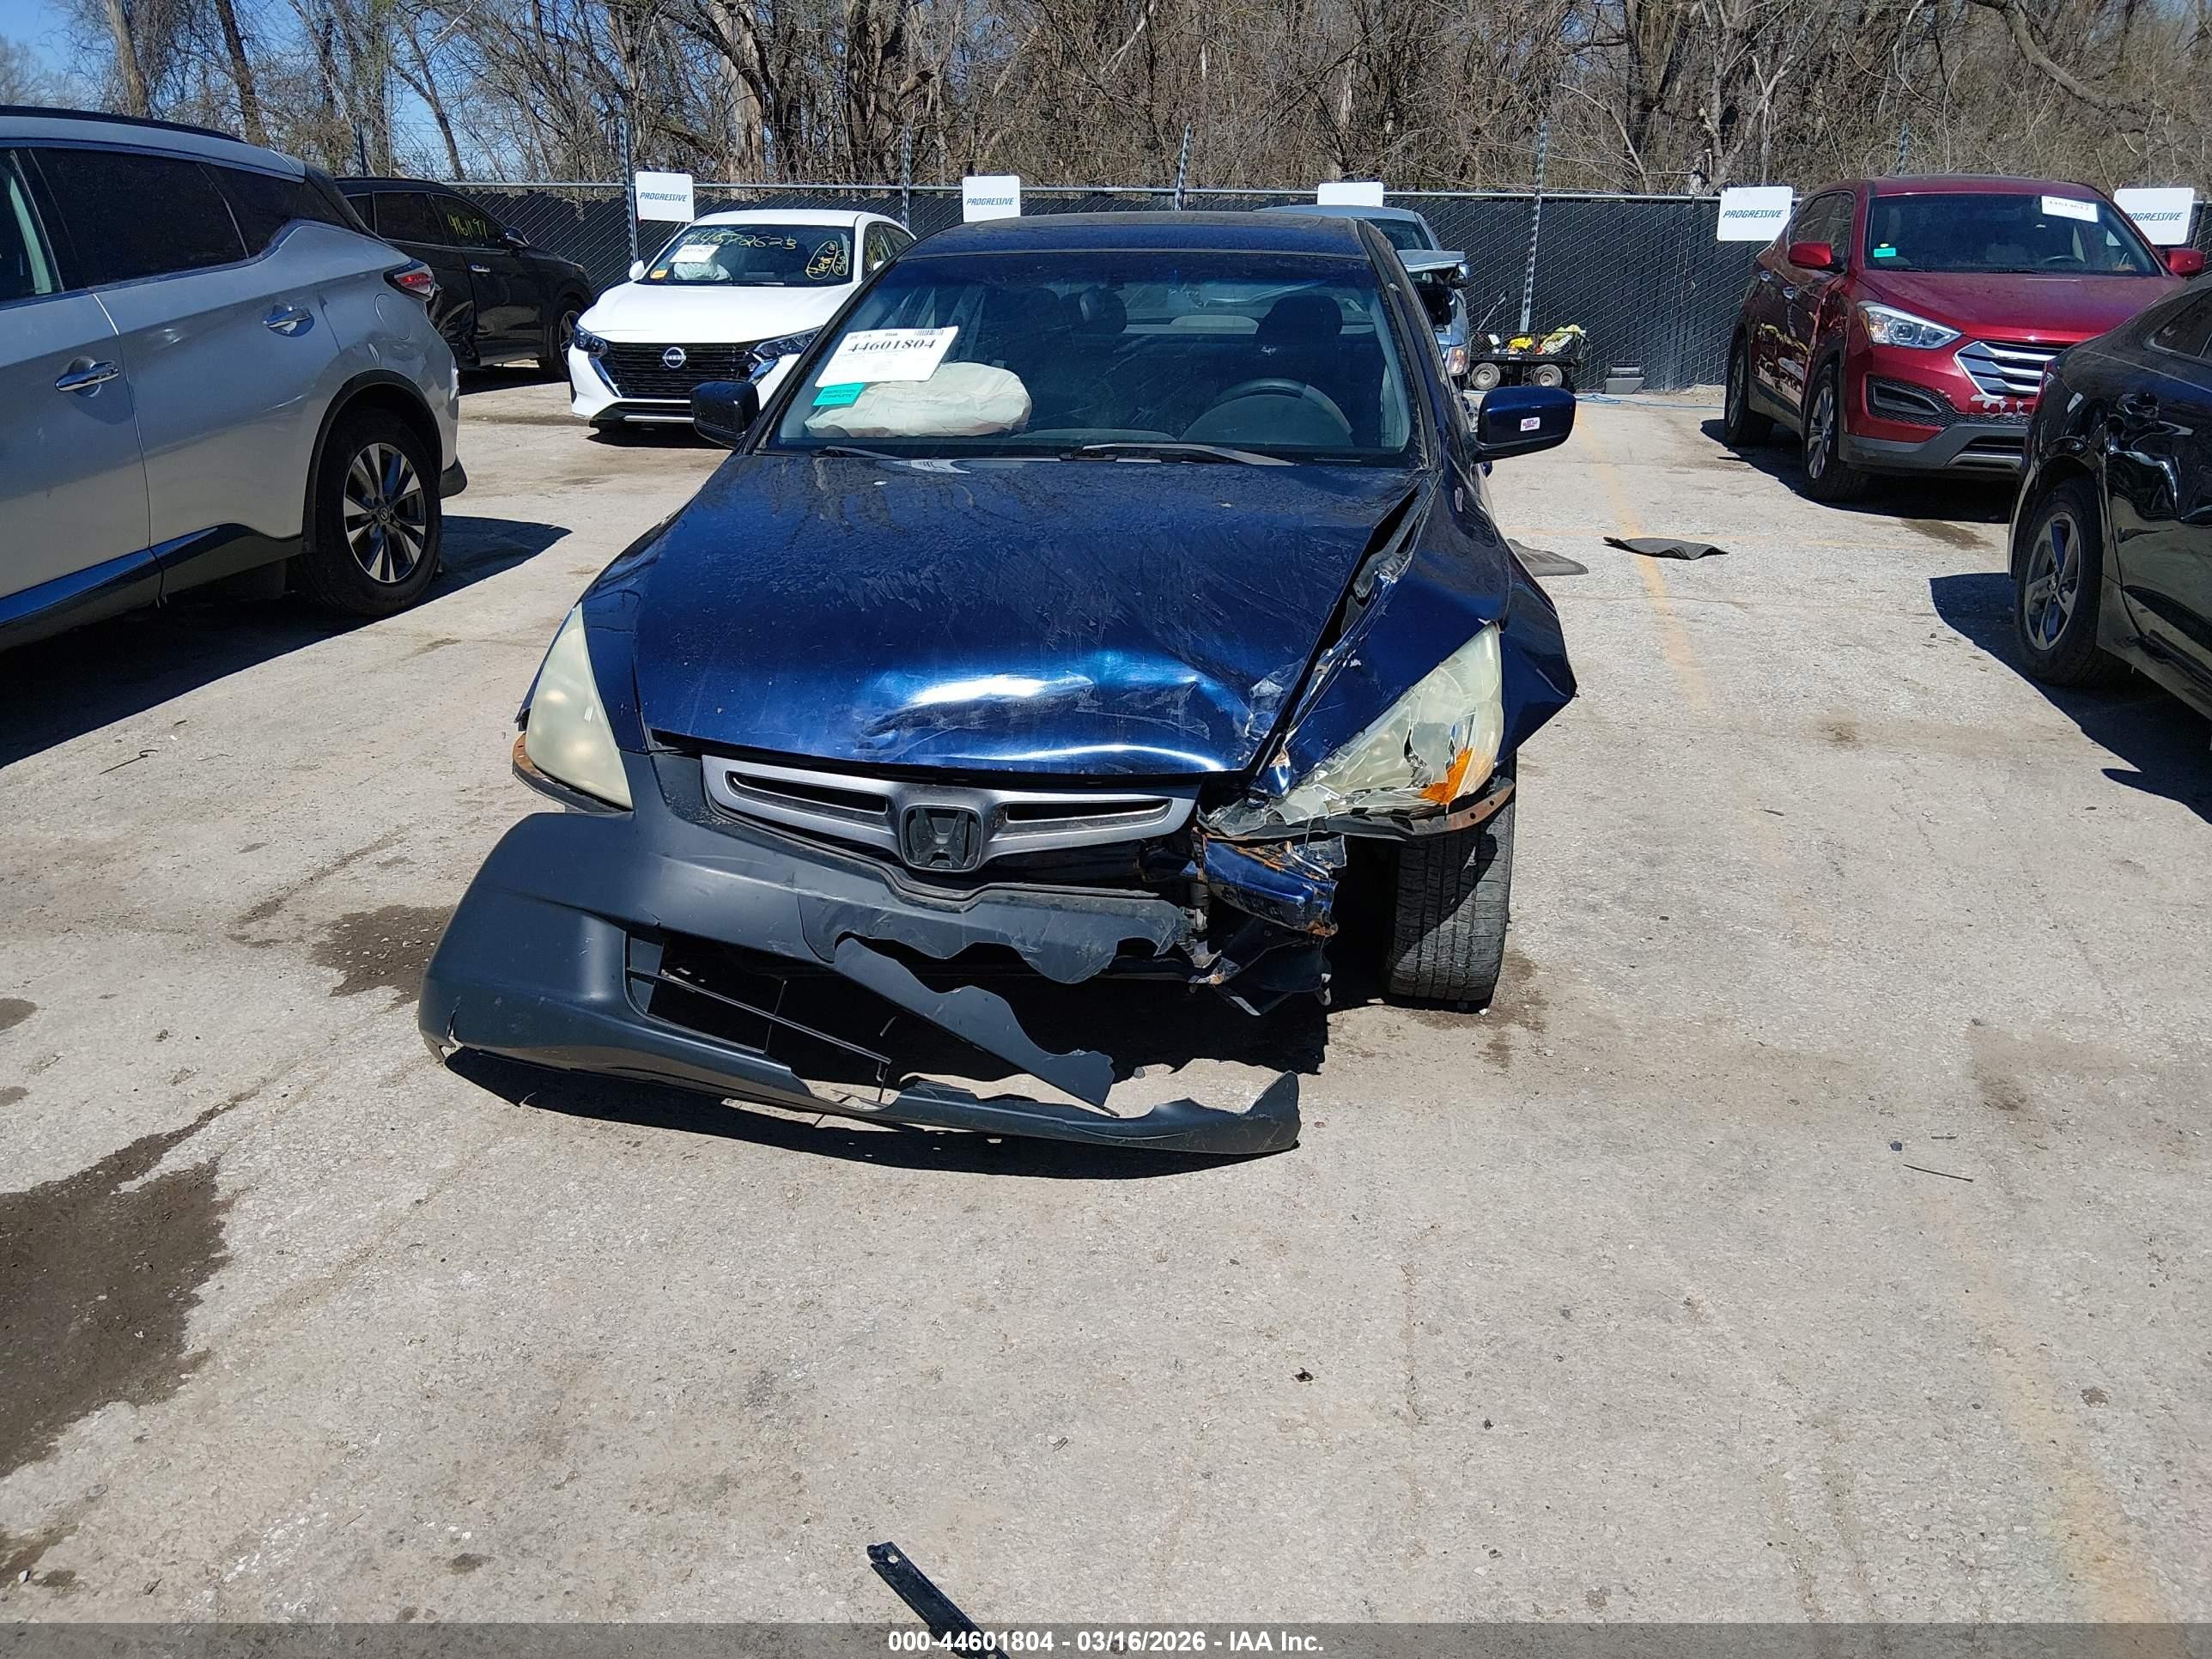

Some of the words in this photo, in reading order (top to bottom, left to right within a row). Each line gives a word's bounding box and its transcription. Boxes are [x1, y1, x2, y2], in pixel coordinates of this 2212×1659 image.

[639, 191, 688, 203] PROGRESSIVE
[966, 198, 1015, 206] PROGRESSIVE
[1723, 210, 1784, 218] PROGRESSIVE
[2125, 212, 2184, 222] OGRESSIVE
[848, 339, 937, 353] 44601804
